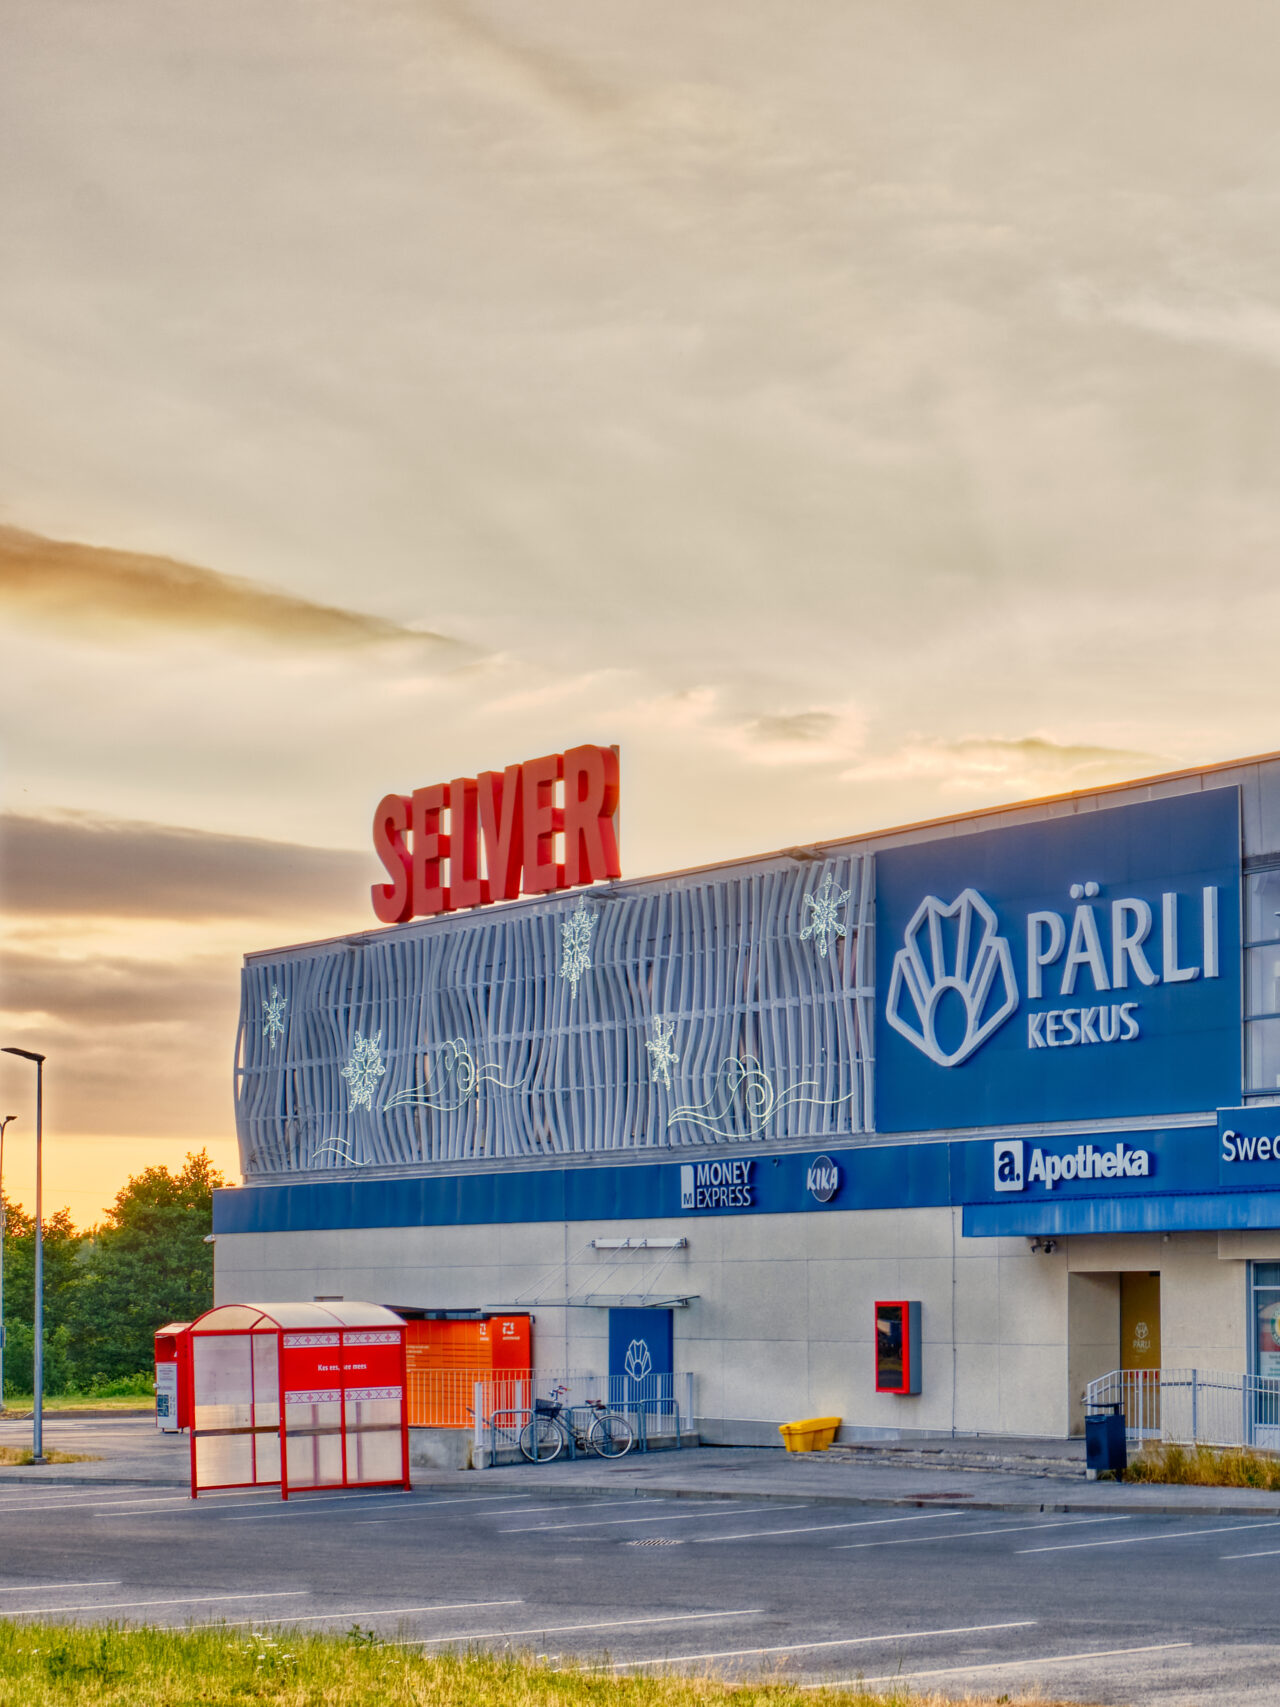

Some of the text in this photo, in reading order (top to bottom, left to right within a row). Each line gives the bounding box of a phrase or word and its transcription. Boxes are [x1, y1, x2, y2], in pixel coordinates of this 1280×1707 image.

[371, 744, 621, 924] SELVER
[1027, 881, 1219, 999] PÄRLI
[1028, 1002, 1139, 1049] KESKUS
[697, 1161, 751, 1186] MONEY
[806, 1166, 839, 1191] KIKA
[1028, 1143, 1150, 1190] Apotheka
[683, 1192, 692, 1206] M
[697, 1185, 751, 1208] EXPRESS
